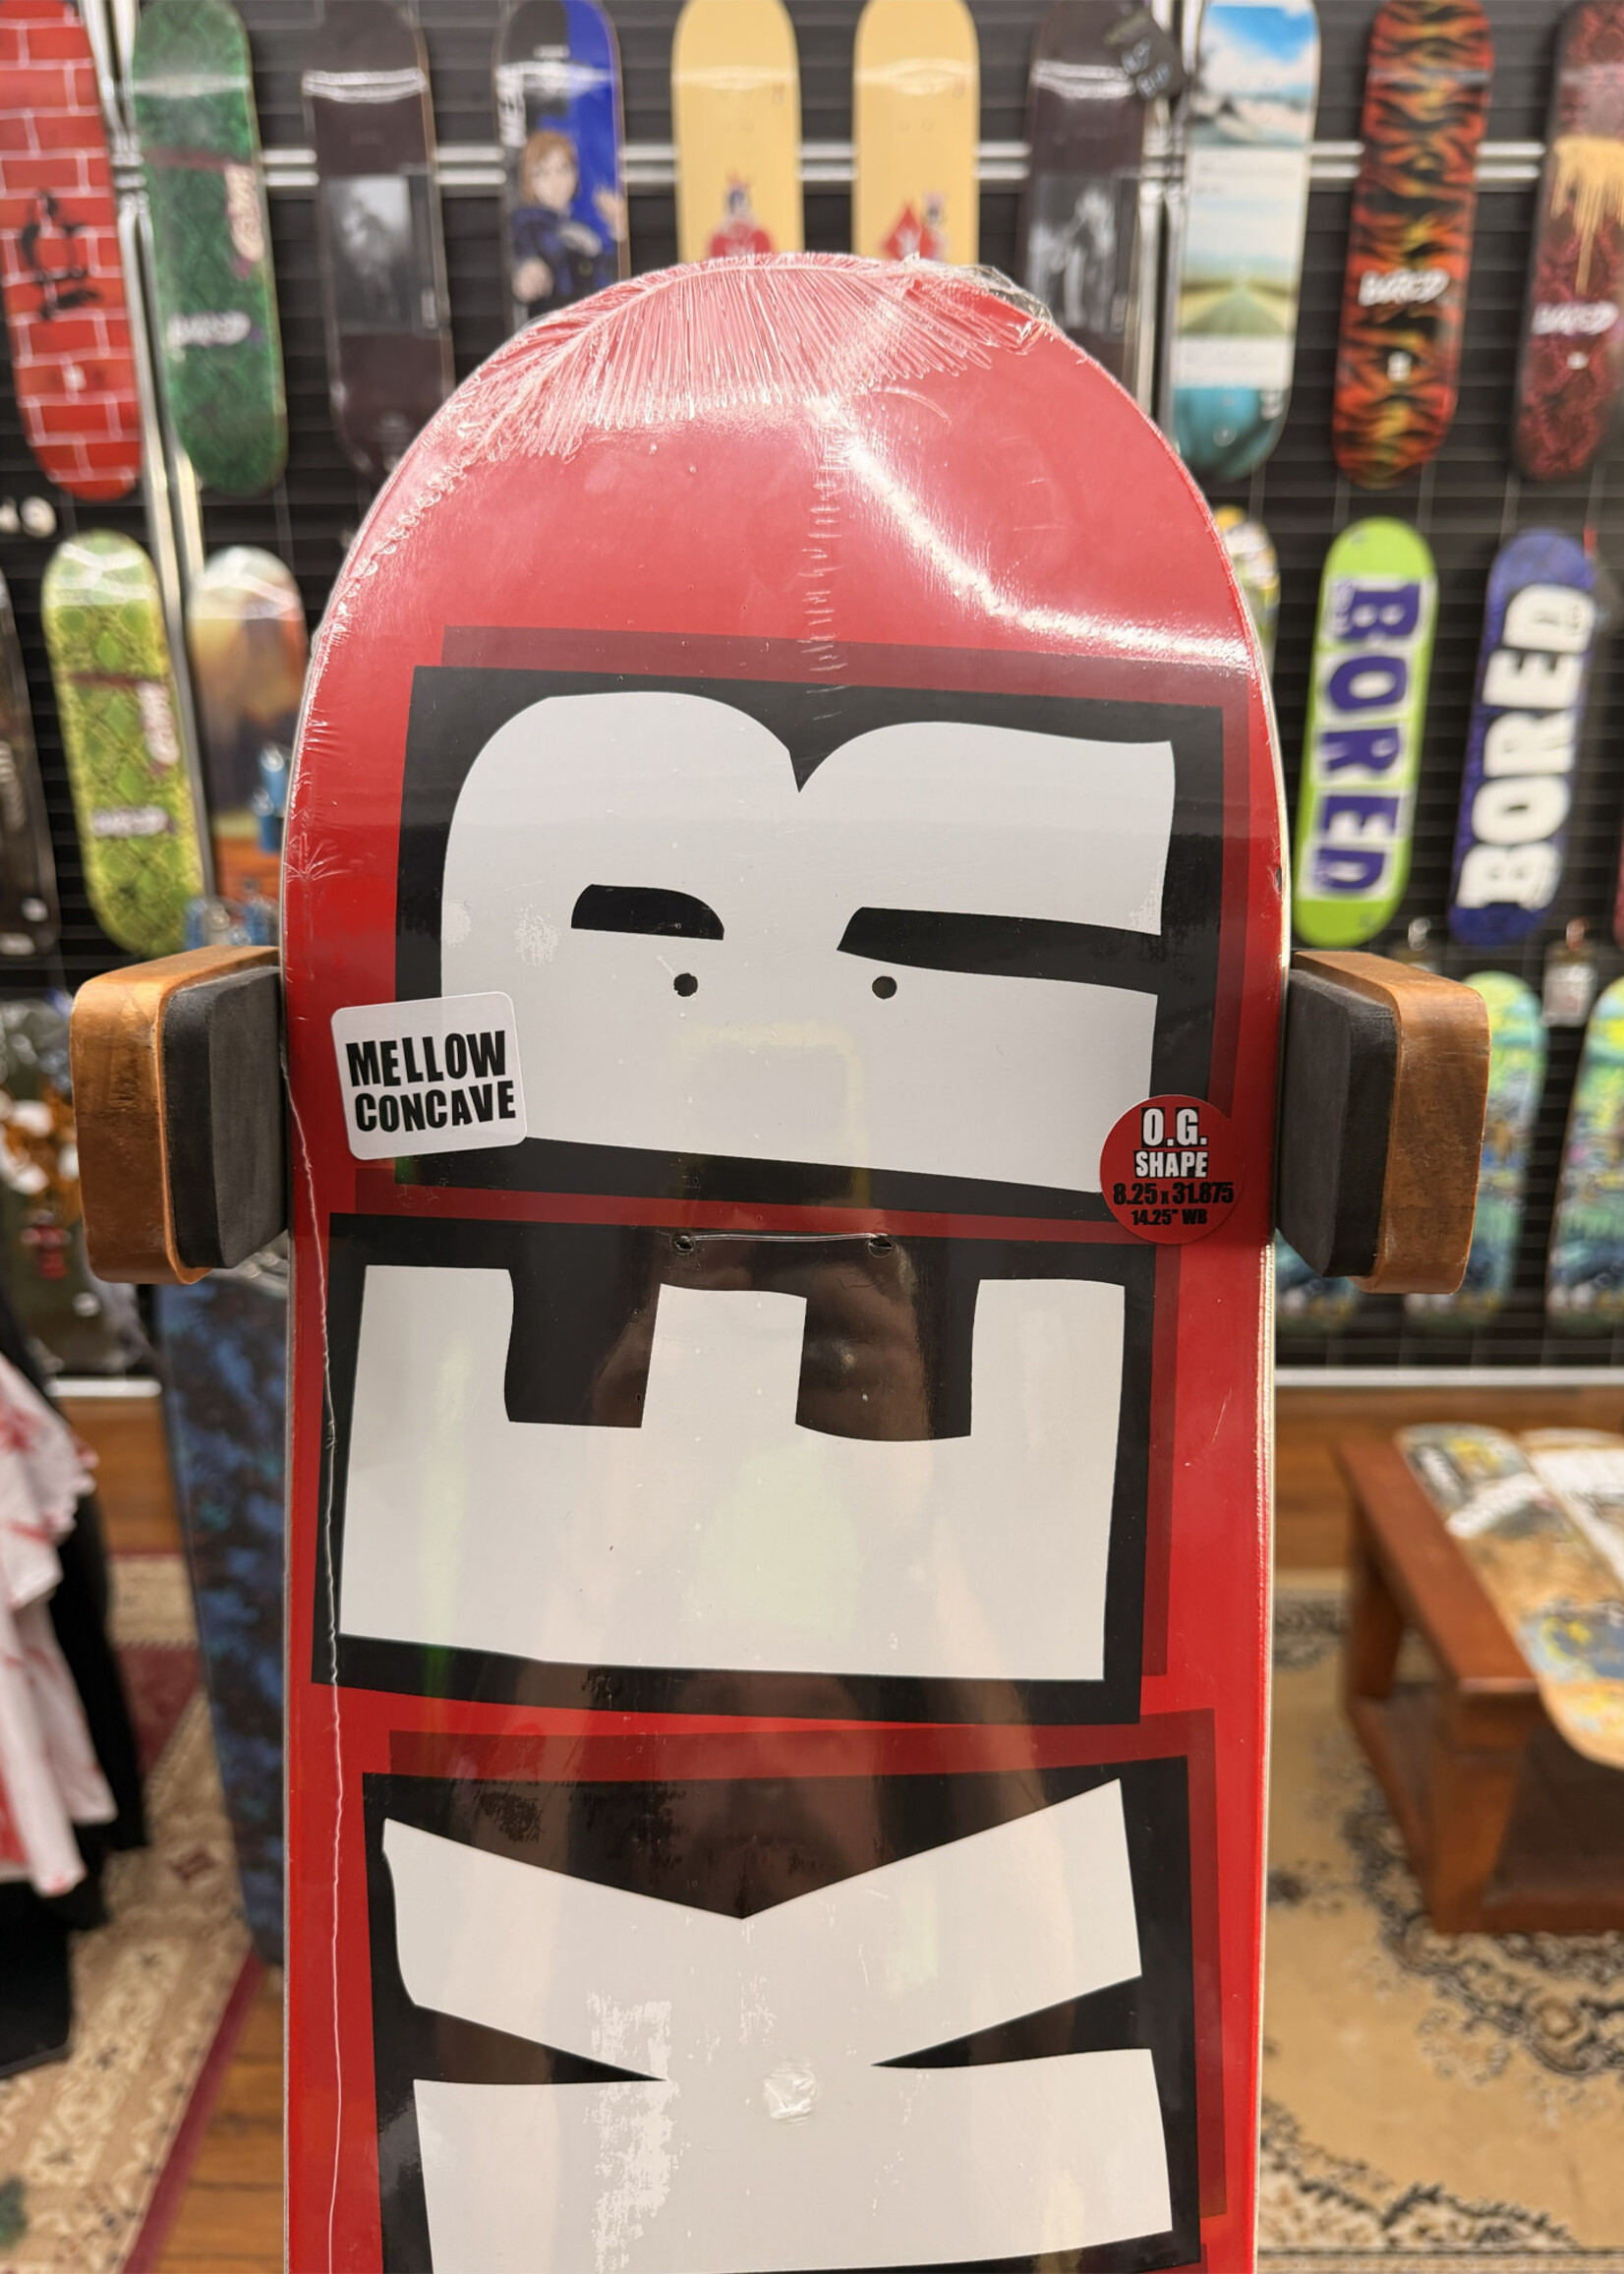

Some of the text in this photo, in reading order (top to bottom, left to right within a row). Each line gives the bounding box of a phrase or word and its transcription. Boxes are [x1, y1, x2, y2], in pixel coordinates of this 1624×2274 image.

[1315, 584, 1421, 891] BORED
[1457, 584, 1595, 910] BORED
[346, 1030, 506, 1087] MELLOW
[355, 1080, 516, 1133] CONCAVE
[1142, 1107, 1208, 1147] O.G.
[1134, 1150, 1208, 1178] SHAPE
[1113, 1183, 1157, 1205] 8.25
[1172, 1182, 1234, 1204] 31.875
[1131, 1208, 1208, 1226] 14.25" WB
